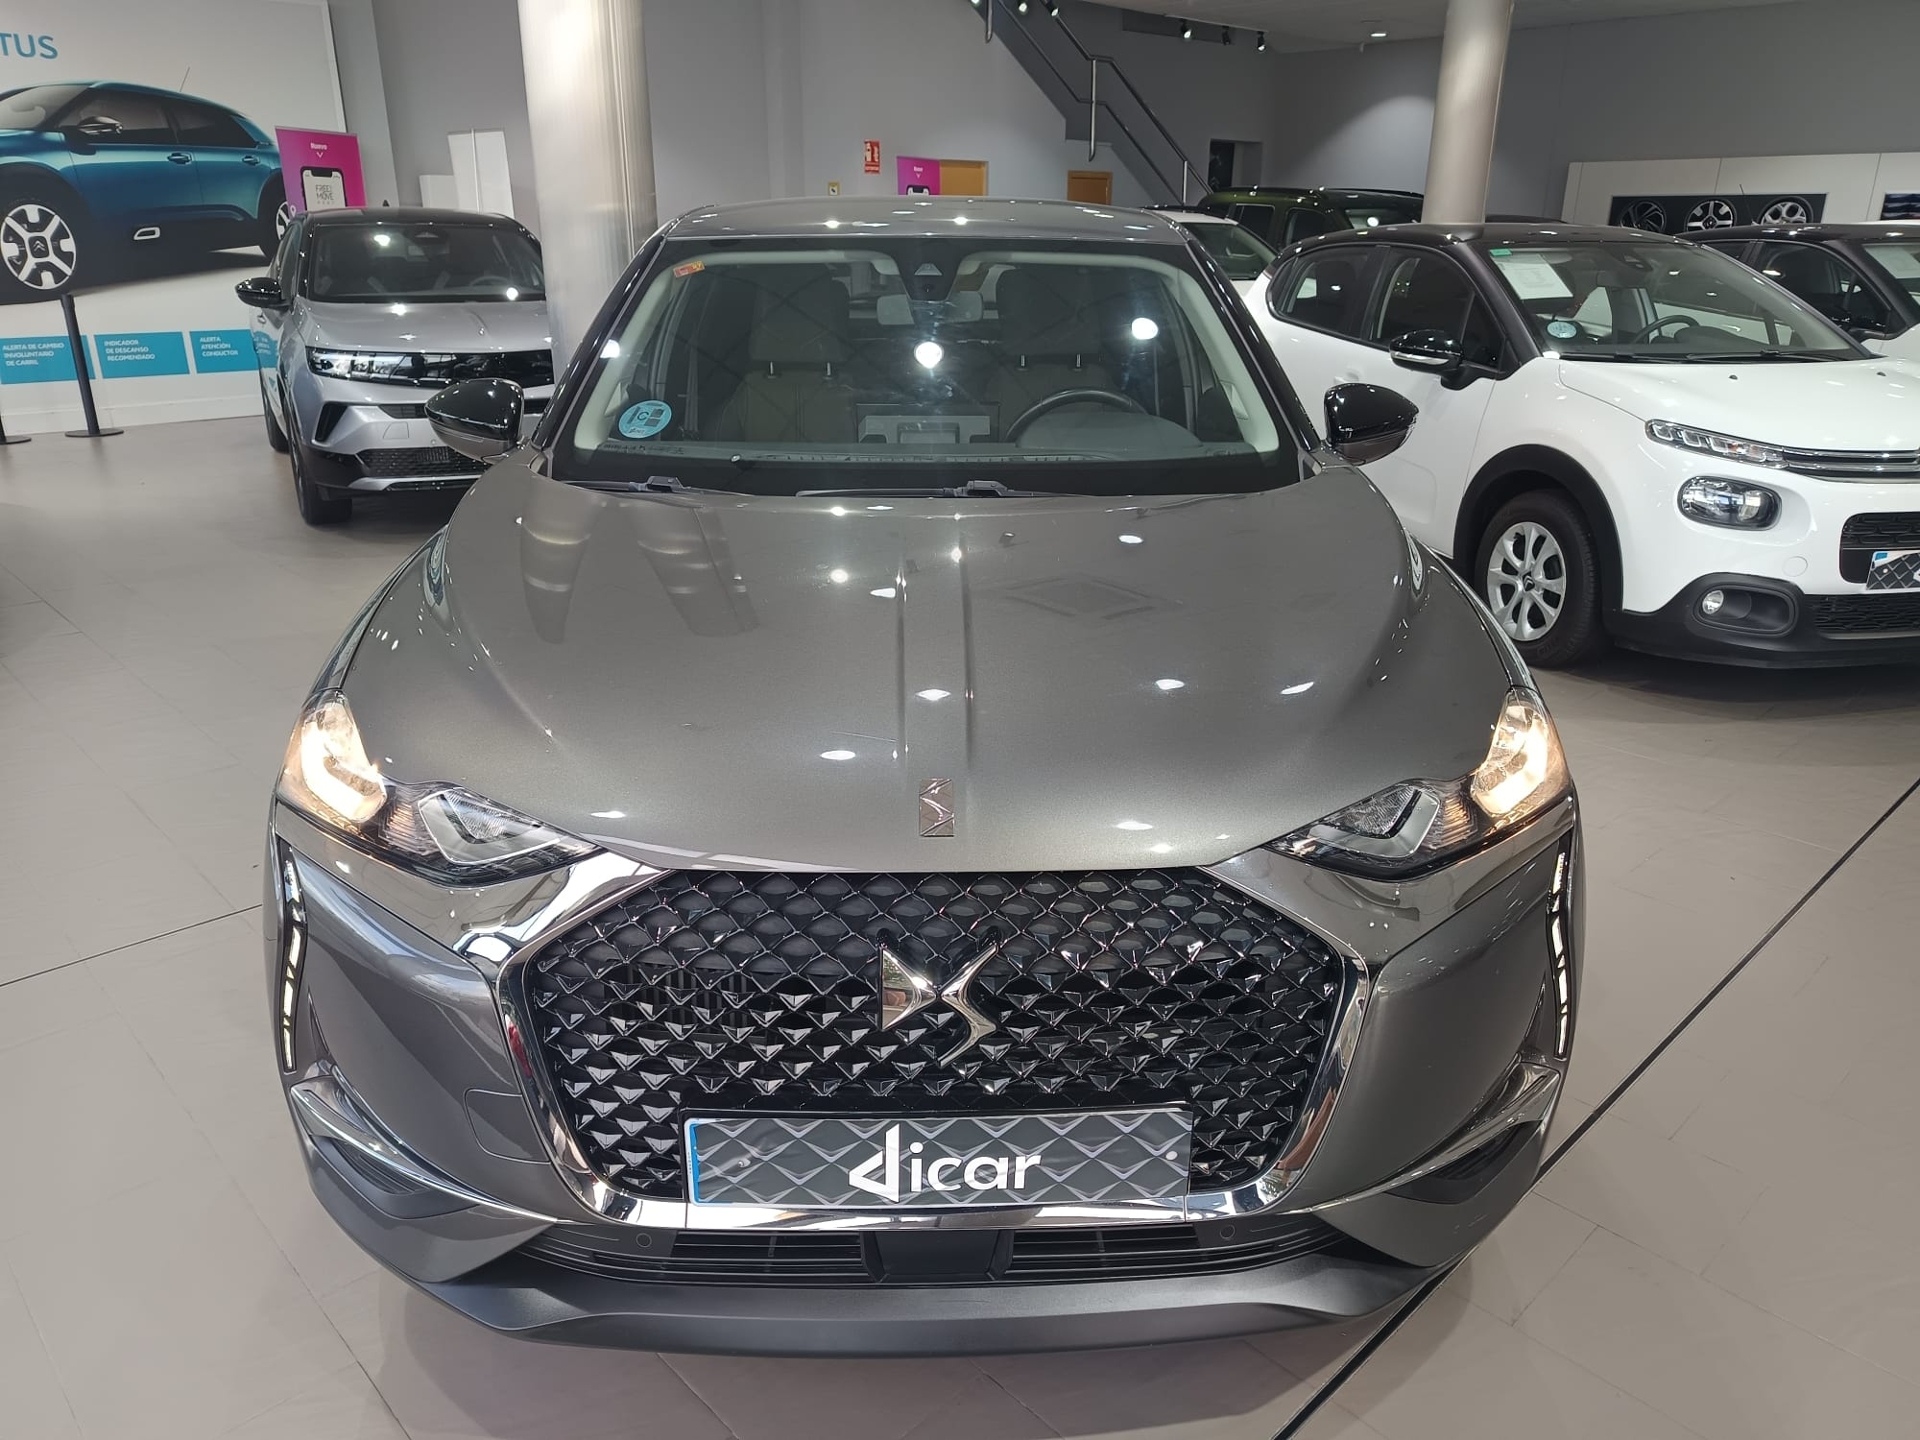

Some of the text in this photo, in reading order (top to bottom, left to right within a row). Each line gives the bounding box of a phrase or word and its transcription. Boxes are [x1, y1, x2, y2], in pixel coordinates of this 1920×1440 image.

[2, 343, 28, 351] ALERTA
[104, 339, 139, 347] INDICADOR
[3, 350, 55, 359] INVOLUNTARIO
[107, 353, 156, 361] RECOMENDADO
[849, 1124, 1042, 1203] dicar
